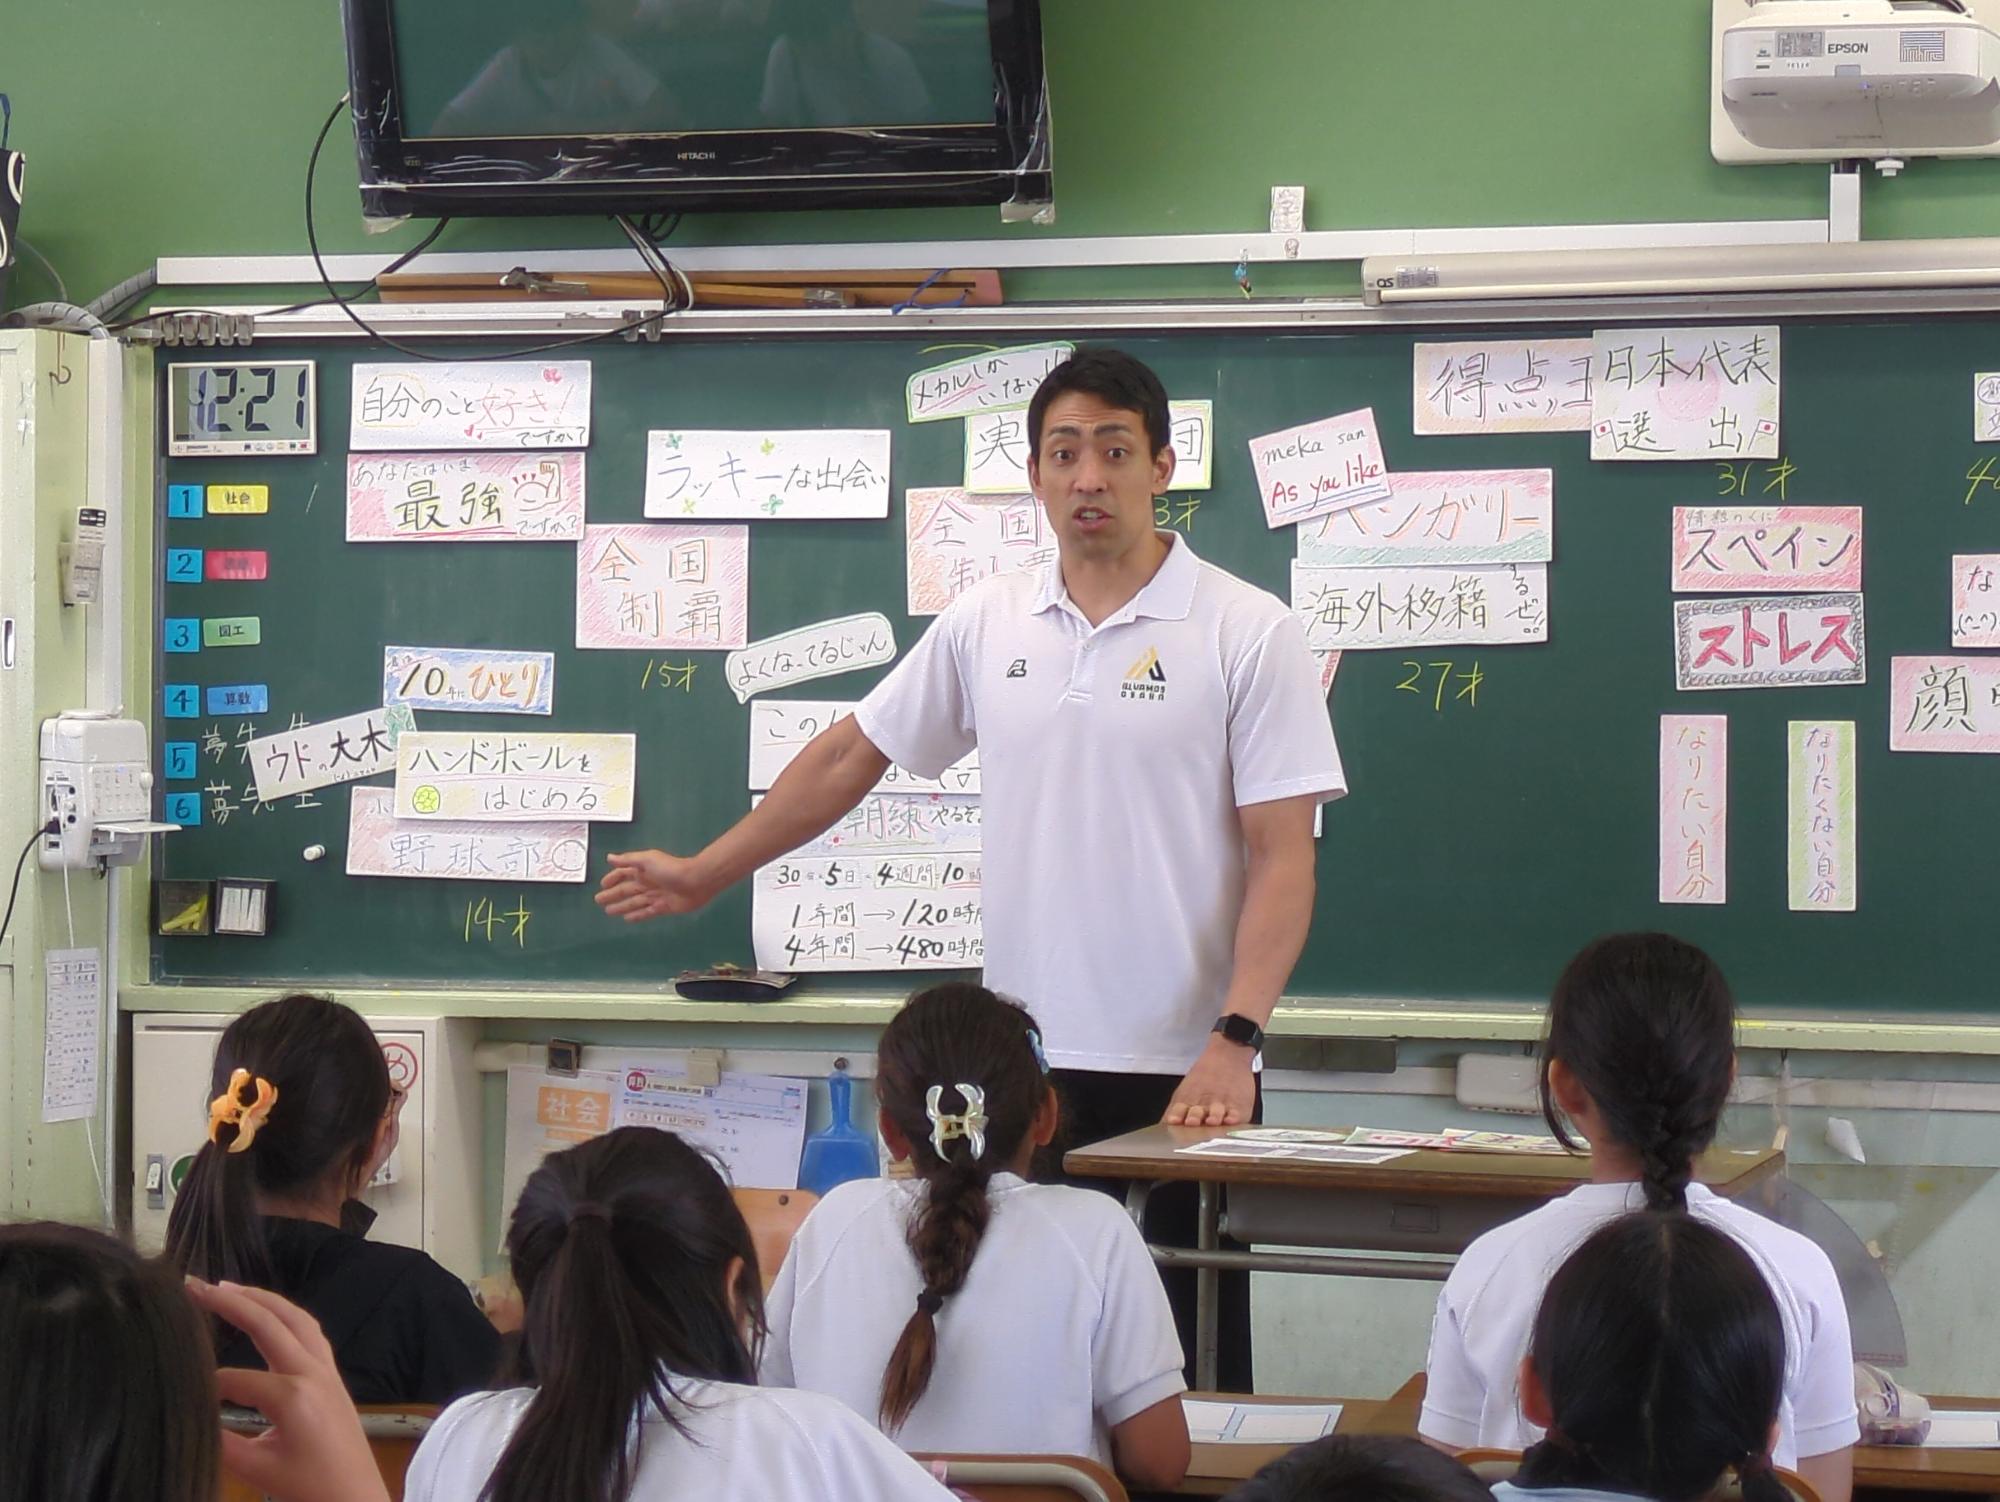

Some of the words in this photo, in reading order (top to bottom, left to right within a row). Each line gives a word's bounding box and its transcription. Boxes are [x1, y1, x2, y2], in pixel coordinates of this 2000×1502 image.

[1827, 43, 1869, 54] EPSON
[677, 151, 716, 160] HITACHI
[1604, 334, 1777, 388] 日本代表
[197, 368, 306, 431] 12:21
[1263, 435, 1324, 466] meka
[1337, 430, 1367, 444] san
[658, 451, 886, 500] ラッキーな出会い
[1272, 481, 1298, 508] As
[1305, 475, 1341, 512] you
[1346, 454, 1384, 487] like
[1715, 457, 1798, 501] 31才
[182, 490, 190, 513] 1
[394, 480, 503, 531] 最強
[916, 495, 1041, 547] 全国
[175, 553, 195, 574] 2
[590, 537, 706, 584] 全国
[1681, 526, 1854, 571] スペイン
[617, 590, 722, 641] 制覇
[1302, 575, 1488, 636] 海外移籍
[174, 624, 189, 647] 3
[1693, 606, 1858, 668] ストレス
[641, 658, 698, 693] 15才
[1396, 661, 1484, 711] 27才
[173, 690, 192, 712] 4
[172, 747, 190, 772] 5
[267, 718, 395, 782] ウドの大木
[409, 738, 593, 774] ハンドボールを
[175, 799, 192, 820] 6
[484, 786, 598, 811] はじめる
[1676, 727, 1713, 898] なりたい自分
[1807, 728, 1836, 902] なりたくない自分
[391, 834, 542, 876] 野球部
[465, 894, 531, 948] 14才
[544, 1094, 601, 1124] 社会
